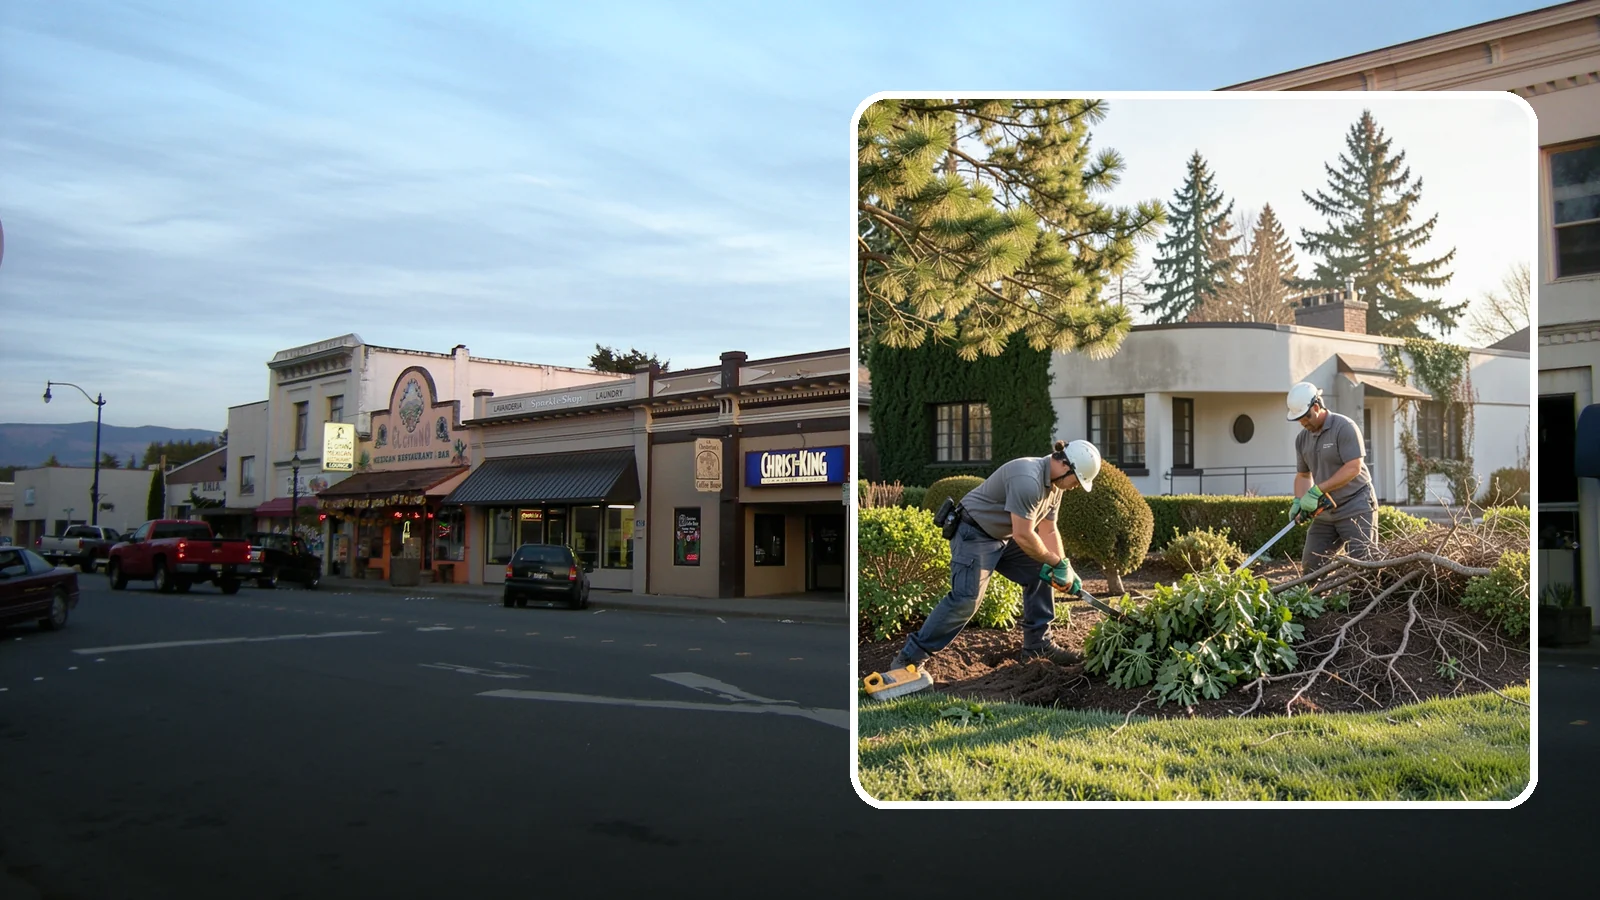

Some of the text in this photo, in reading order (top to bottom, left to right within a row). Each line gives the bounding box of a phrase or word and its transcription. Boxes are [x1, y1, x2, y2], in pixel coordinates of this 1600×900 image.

[563, 394, 582, 405] Shop
[595, 389, 623, 400] LAUNDRY
[493, 402, 522, 413] LAVANDERIA
[373, 455, 396, 464] MEXICAN
[398, 451, 433, 462] RESTAURANT
[438, 450, 450, 459] BAR
[761, 450, 828, 478] CHRIST KING
